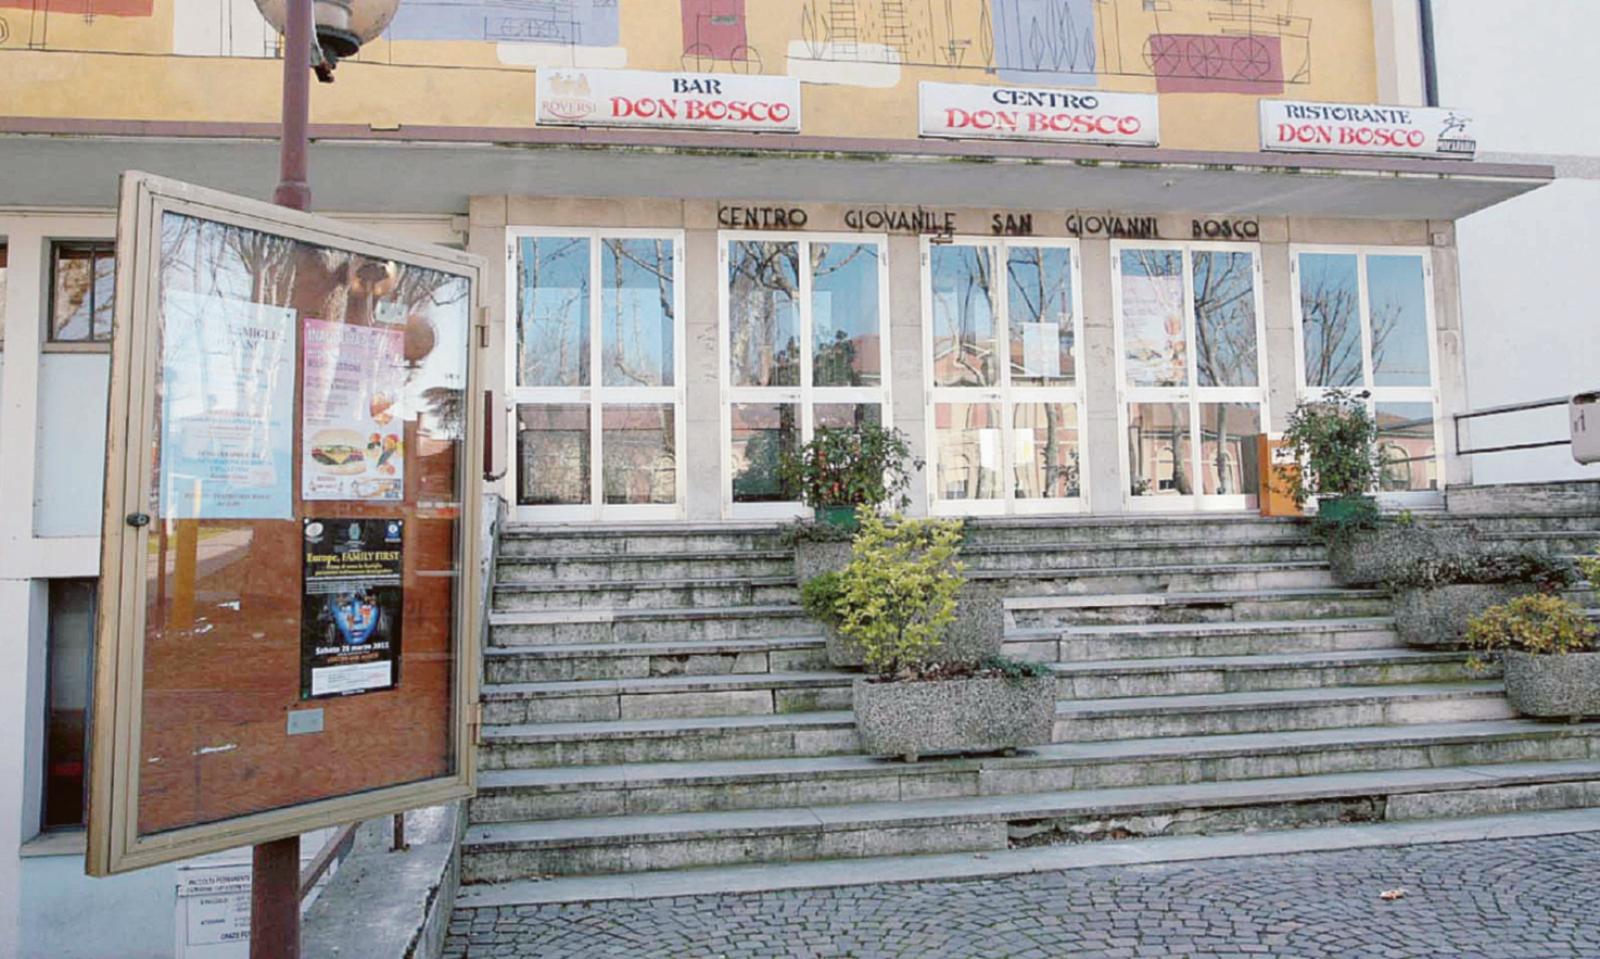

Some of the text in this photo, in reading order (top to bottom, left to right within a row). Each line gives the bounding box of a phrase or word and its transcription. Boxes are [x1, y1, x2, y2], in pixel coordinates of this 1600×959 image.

[673, 78, 722, 95] BAR
[610, 97, 790, 122] DON BOSCO
[993, 89, 1099, 110] CENTRO
[945, 108, 1142, 135] DON BOSCO
[1285, 105, 1412, 124] RISTORANTE
[1278, 124, 1332, 144] DON
[1339, 127, 1425, 147] BOSCO
[718, 207, 1260, 238] CENTRO GIOVANILE SAN GIOVANNI BOSCO
[342, 551, 374, 561] FAMILY
[375, 551, 400, 560] FIRST
